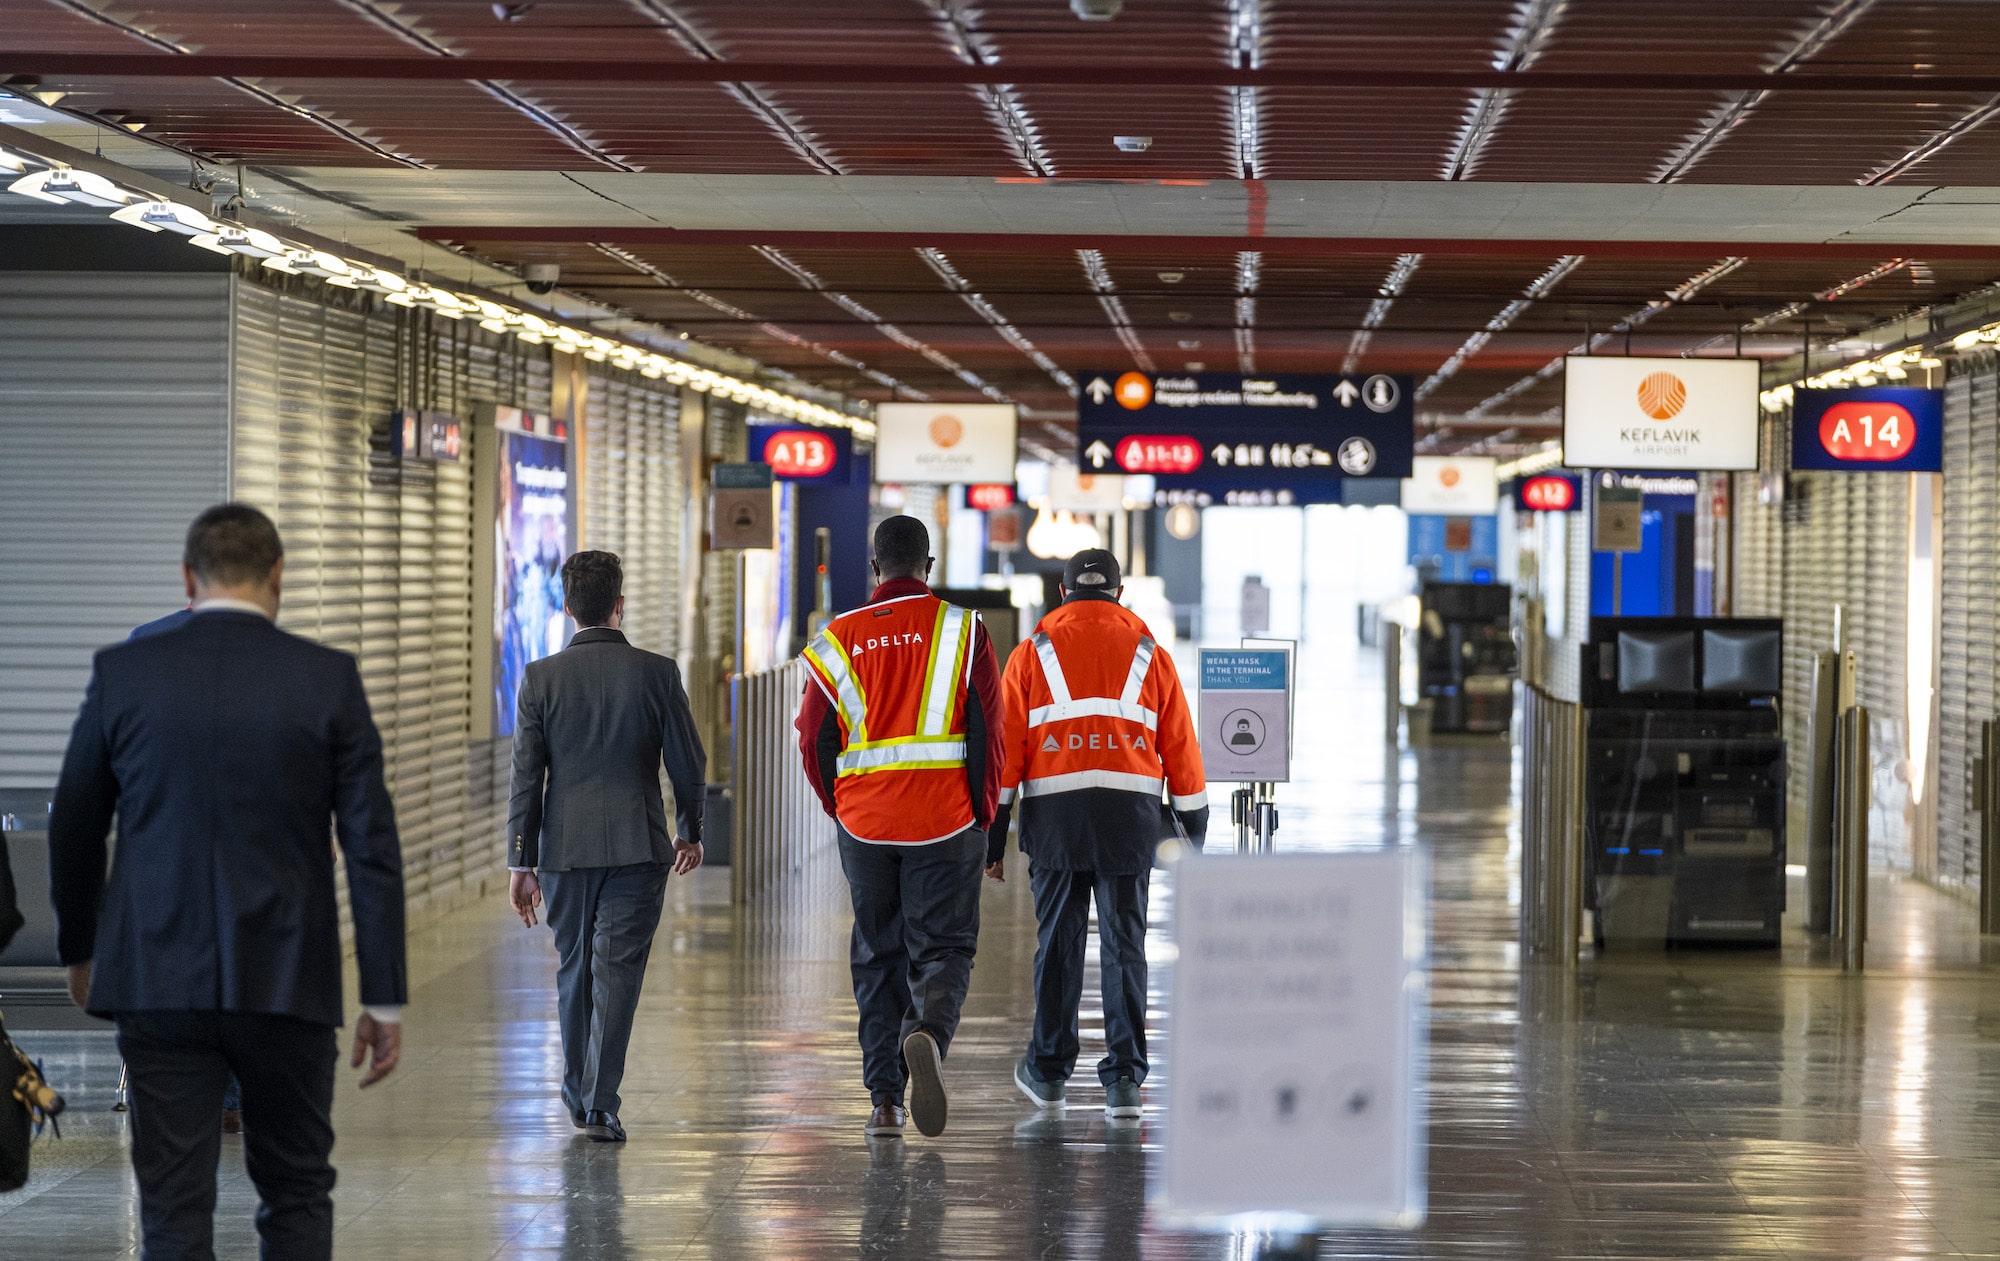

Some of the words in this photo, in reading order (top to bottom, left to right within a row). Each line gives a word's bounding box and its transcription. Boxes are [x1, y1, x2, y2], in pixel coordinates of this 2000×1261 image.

[1620, 428, 1701, 443] KEFLAVIK
[1633, 444, 1689, 456] AIRPORT
[867, 633, 923, 650] DELTA
[1206, 657, 1229, 665] WEAR
[1230, 657, 1236, 665] A
[1238, 657, 1260, 665] MASK
[1068, 733, 1147, 751] DELTA
